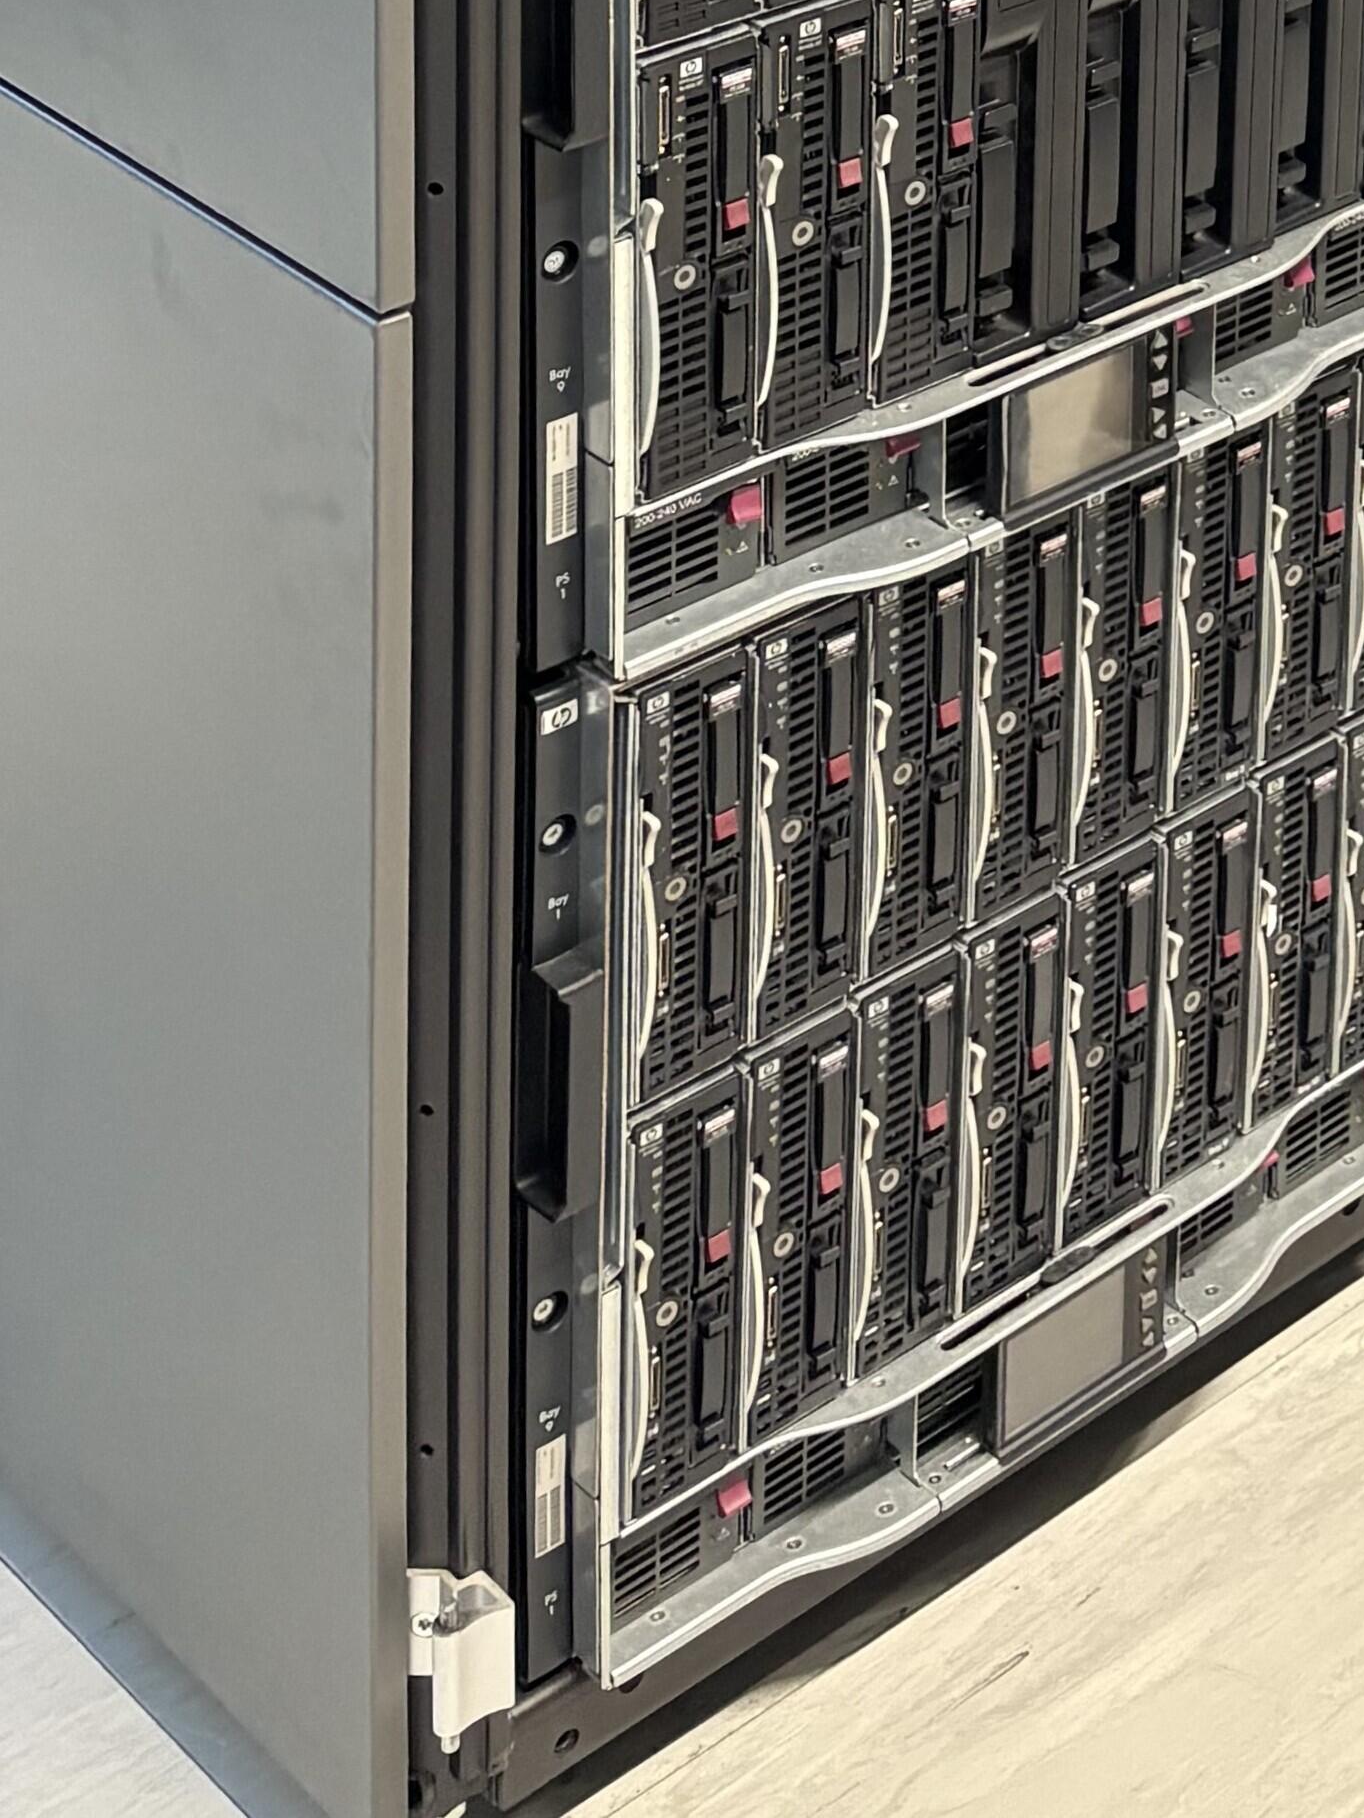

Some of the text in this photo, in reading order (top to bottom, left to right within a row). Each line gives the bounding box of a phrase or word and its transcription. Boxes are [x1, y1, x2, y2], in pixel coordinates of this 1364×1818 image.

[549, 366, 572, 382] Bay
[634, 492, 702, 529] 200-240 VAC
[556, 572, 570, 587] PS
[548, 893, 569, 910] Bay
[539, 1406, 561, 1423] Bay
[544, 1591, 558, 1606] PS
